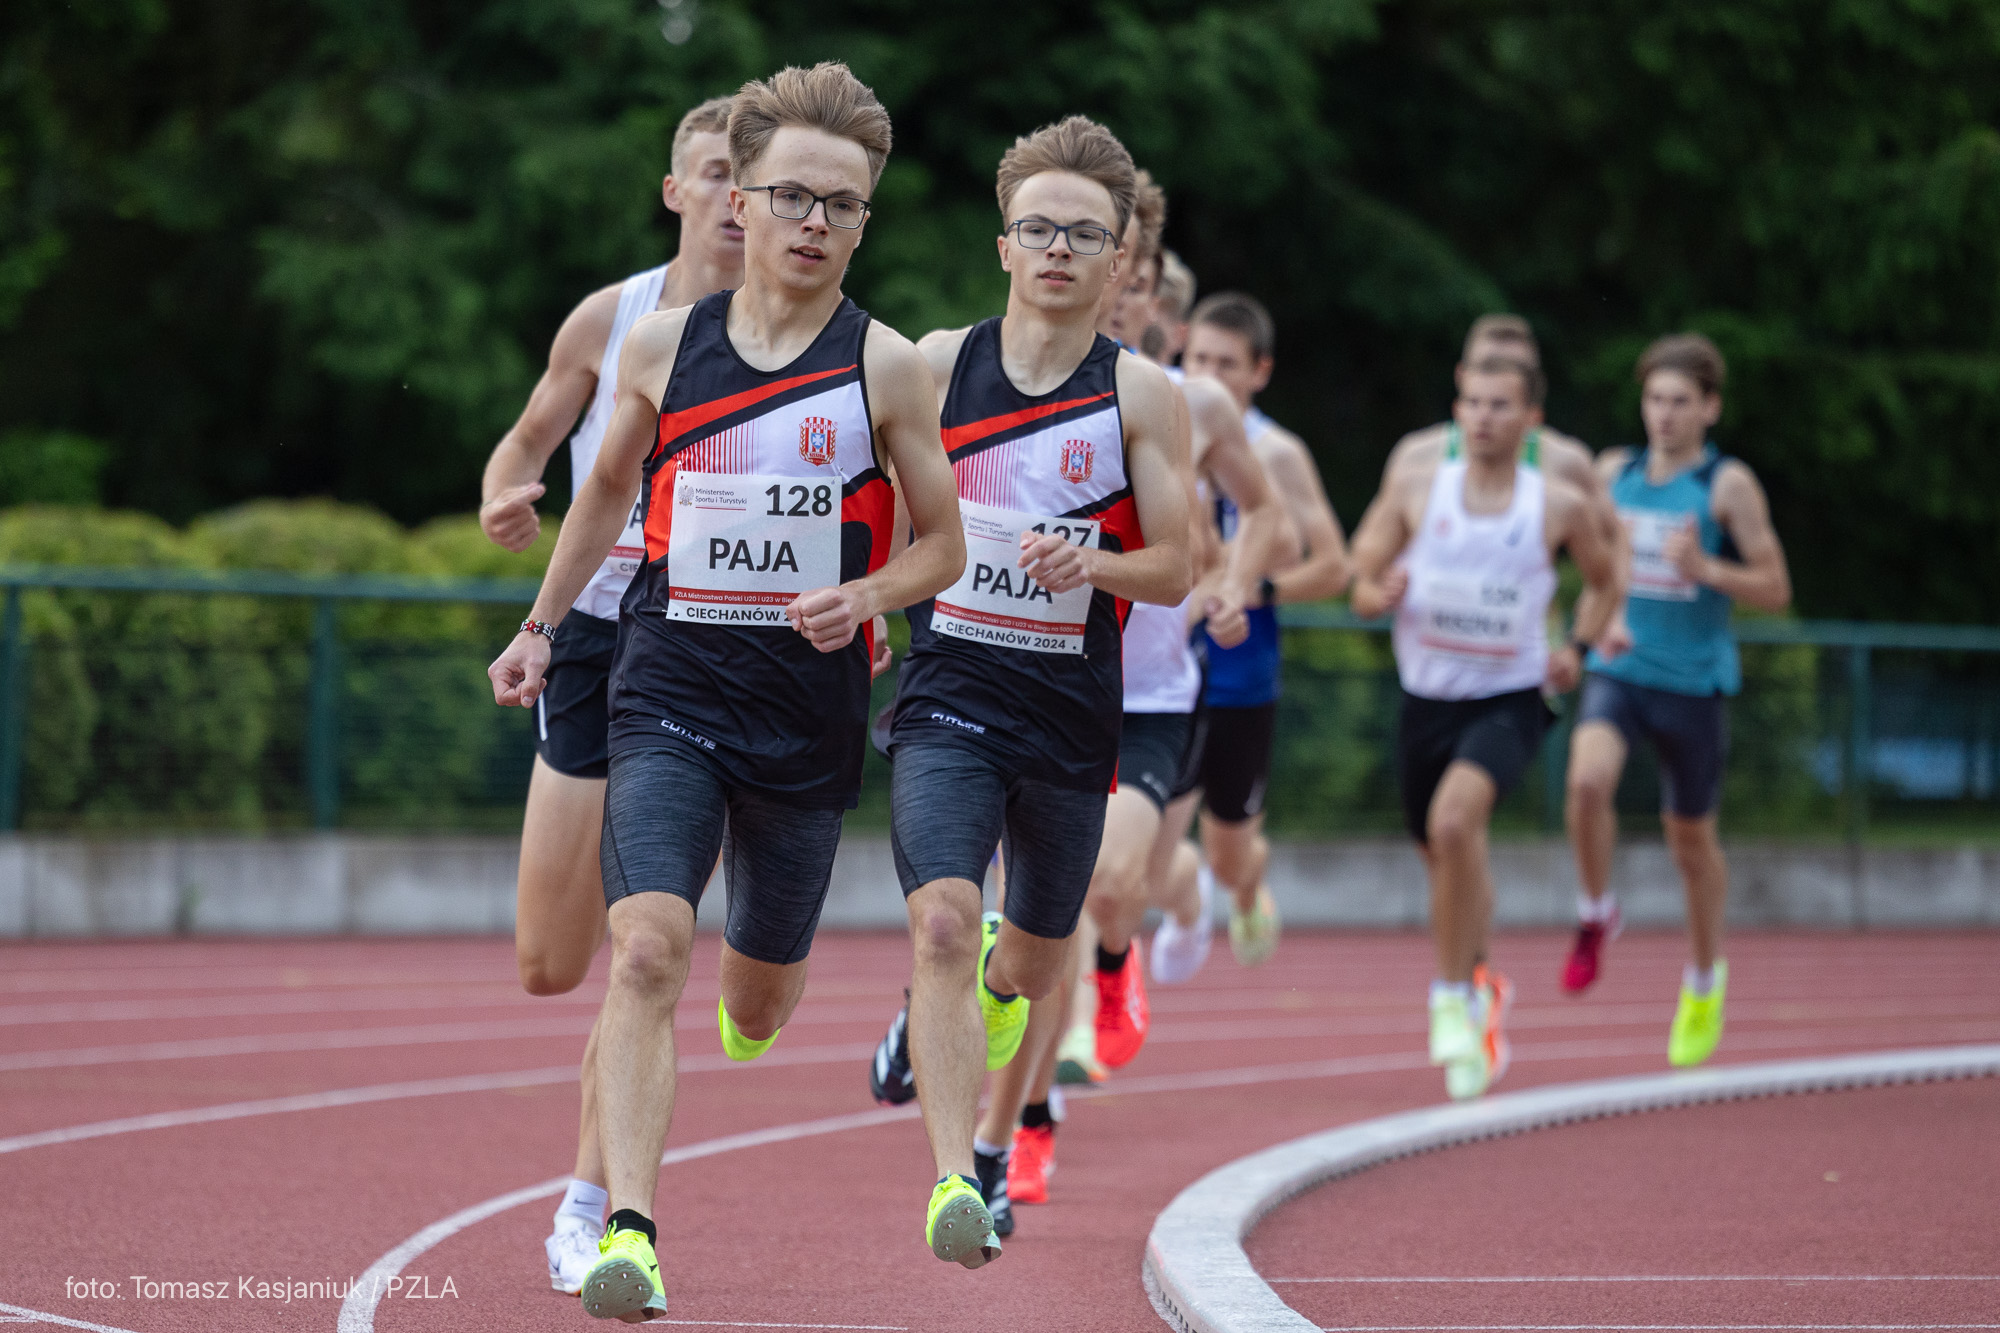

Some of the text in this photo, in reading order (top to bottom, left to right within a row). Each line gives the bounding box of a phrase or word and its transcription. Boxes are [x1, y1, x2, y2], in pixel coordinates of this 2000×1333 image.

[695, 488, 735, 496] Ministerstwo
[695, 496, 715, 504] Sportu
[719, 497, 747, 505] Turystyki
[765, 484, 832, 517] 128
[708, 537, 799, 573] PAJA
[972, 563, 1053, 604] PAJA
[674, 591, 688, 599] PZLA
[688, 592, 723, 601] Mistrzostwa
[686, 606, 781, 622] CIECHANÓW
[946, 621, 1066, 649] CIECHANÓW 2024
